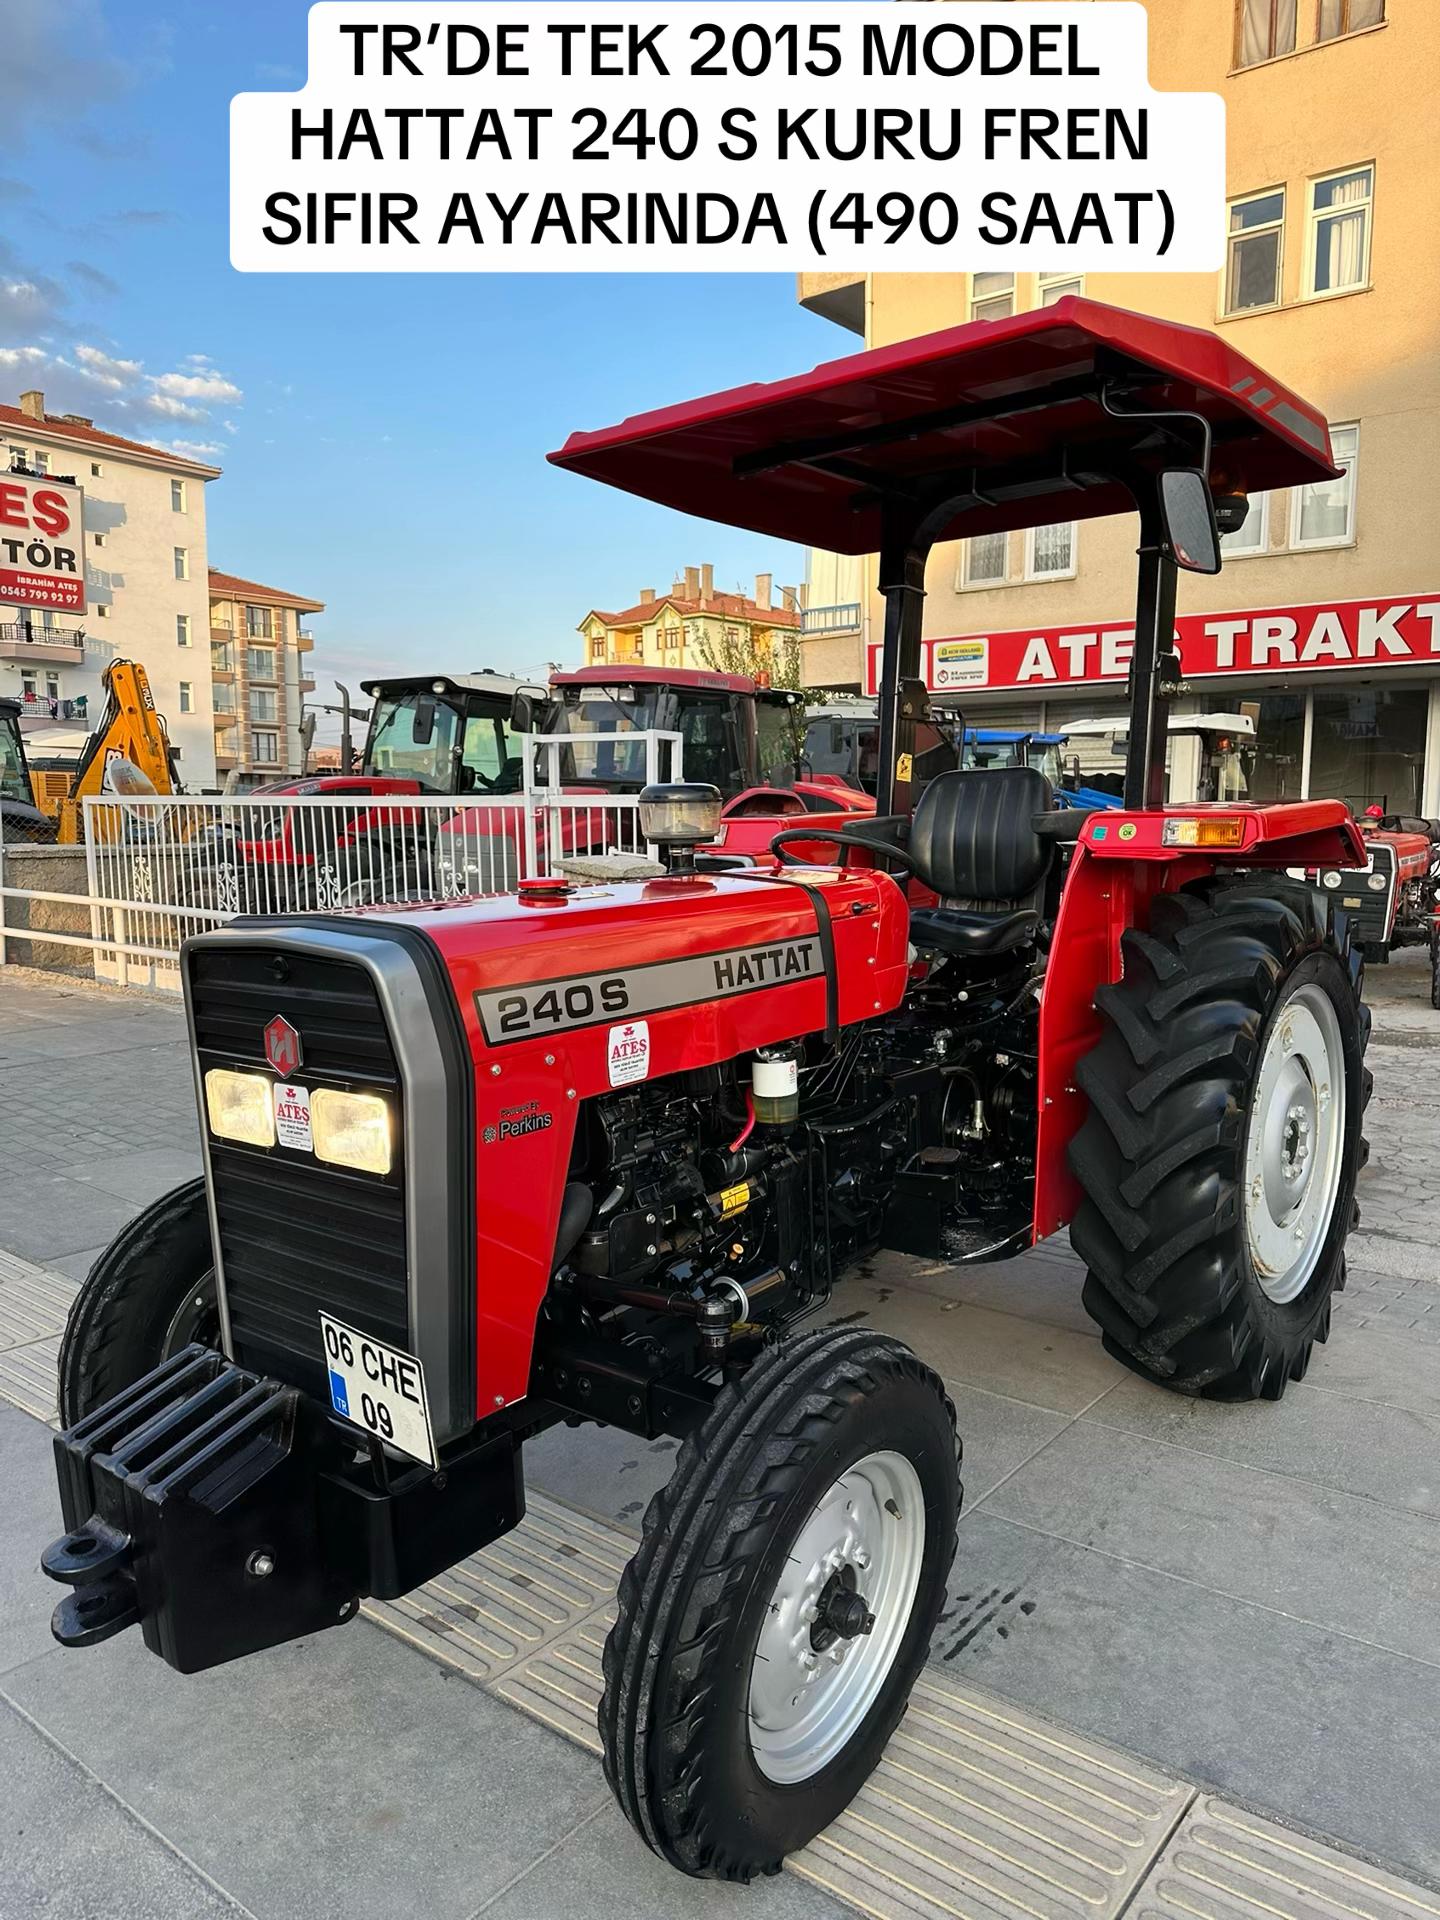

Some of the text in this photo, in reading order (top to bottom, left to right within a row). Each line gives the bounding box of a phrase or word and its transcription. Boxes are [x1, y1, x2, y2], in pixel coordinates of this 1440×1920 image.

[1, 537, 77, 573] TÖR
[0, 585, 79, 605] 0545 799 92 97
[17, 574, 56, 588] İBRAHİM
[1016, 628, 1182, 681] ATE
[713, 943, 813, 990] HATTAT
[500, 1113, 553, 1140] Perkins
[325, 1323, 420, 1404] 06 CHE
[336, 1392, 394, 1439] TR 09
